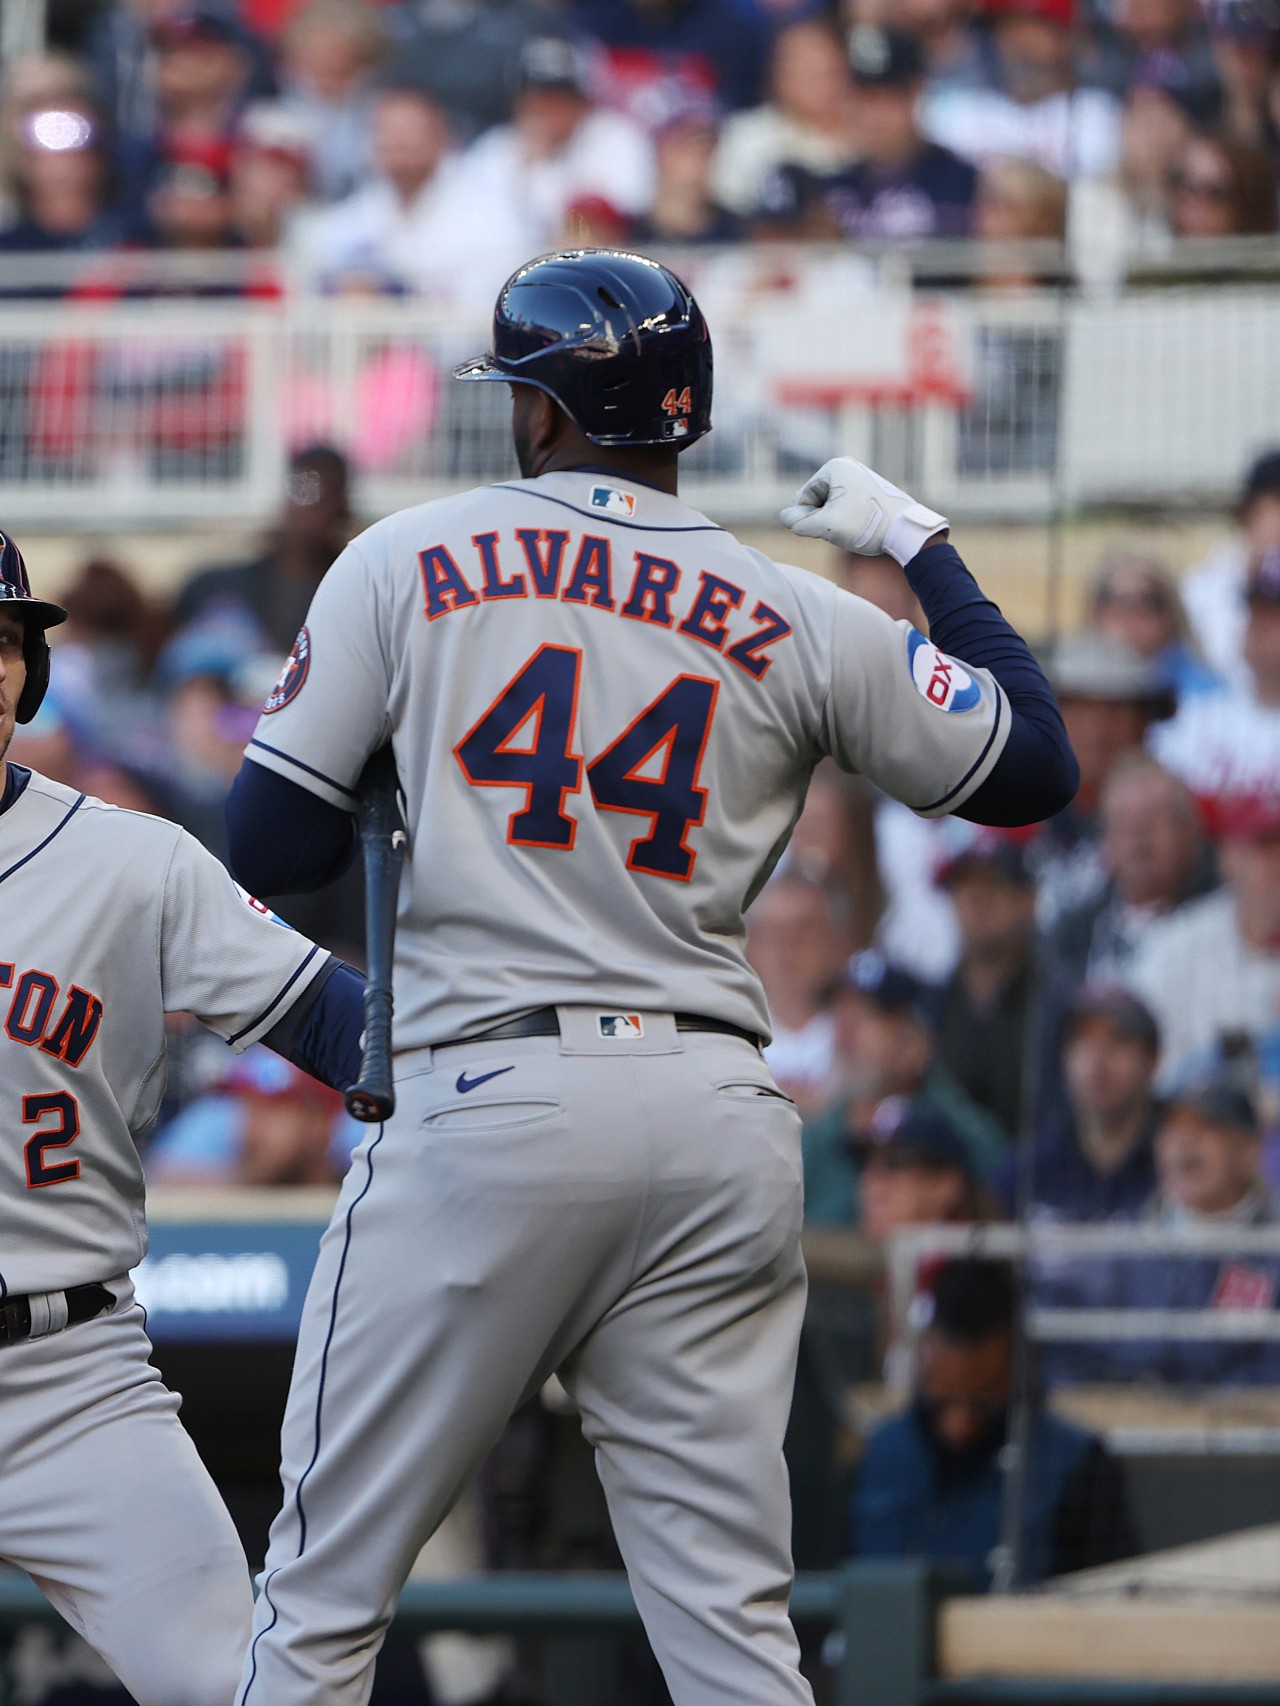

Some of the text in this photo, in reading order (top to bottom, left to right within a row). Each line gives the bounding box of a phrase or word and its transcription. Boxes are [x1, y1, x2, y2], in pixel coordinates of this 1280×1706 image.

[661, 386, 692, 416] 44
[418, 528, 792, 681] ALVAREZ
[926, 647, 953, 706] OX
[452, 642, 720, 882] 44
[22, 1090, 80, 1189] 2
